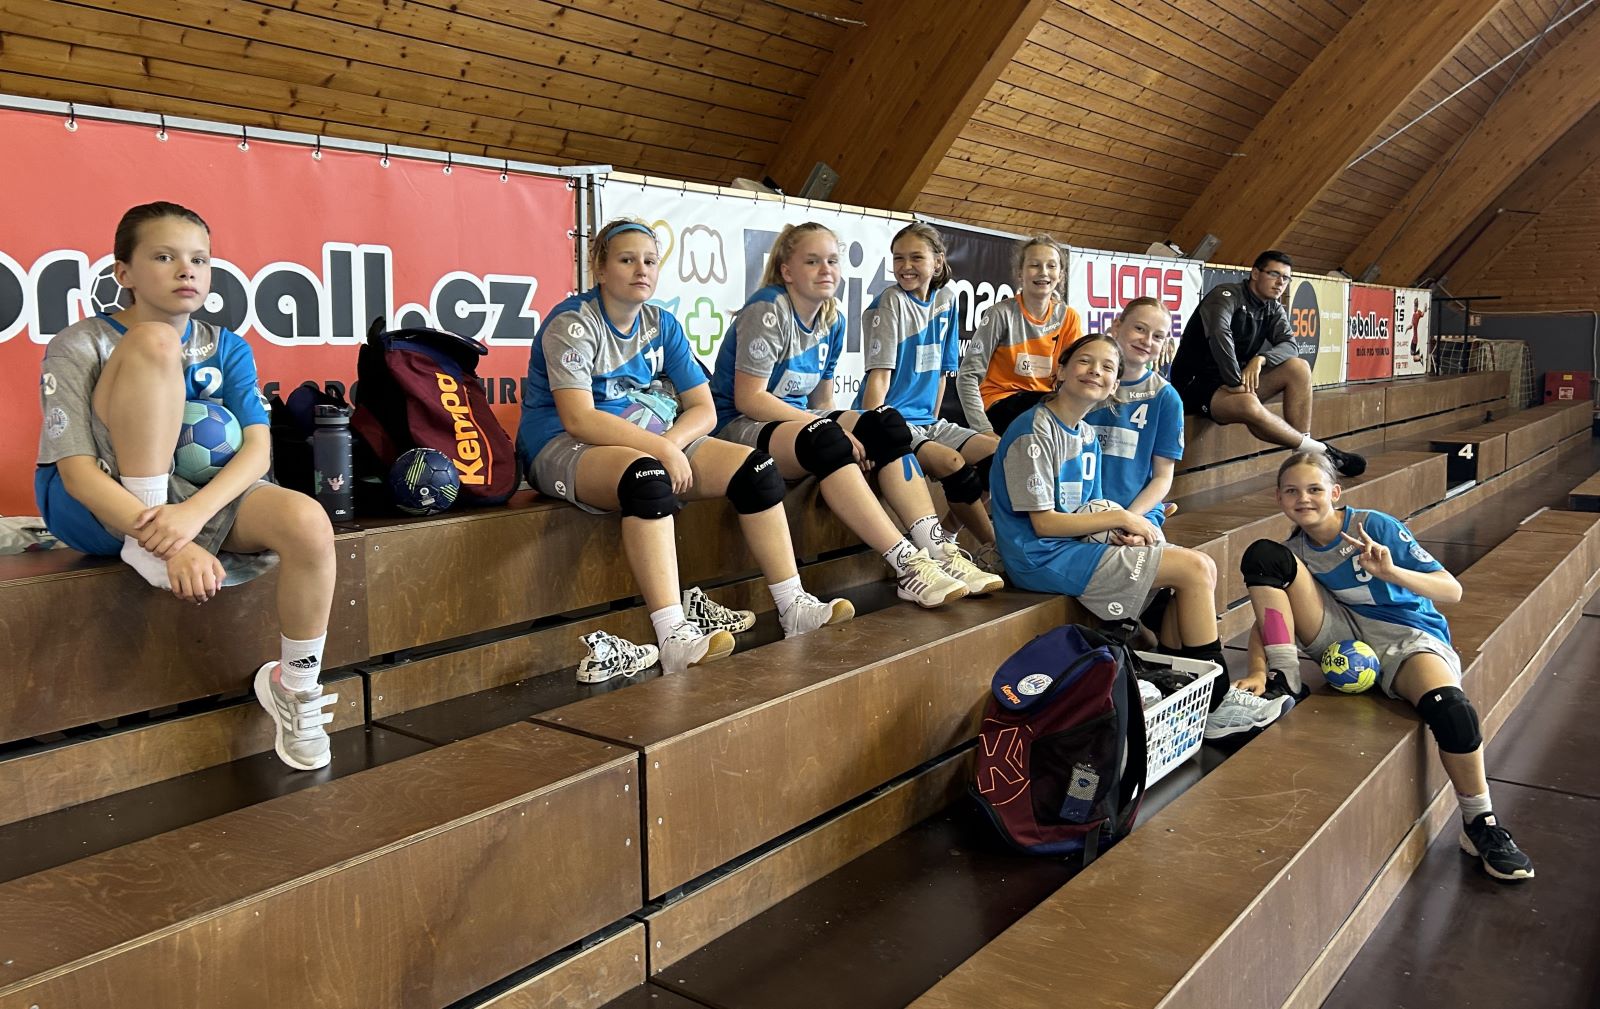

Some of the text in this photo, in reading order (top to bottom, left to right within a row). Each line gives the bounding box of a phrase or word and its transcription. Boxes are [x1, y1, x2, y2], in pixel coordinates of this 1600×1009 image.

[940, 317, 949, 341] 7
[1292, 308, 1317, 337] 360
[819, 343, 829, 370] 9
[194, 366, 223, 405] 2
[1130, 403, 1149, 429] 4
[1458, 443, 1474, 459] 4
[635, 469, 666, 479] Kempa
[1129, 551, 1146, 582] Kempa
[1352, 554, 1373, 582] 5
